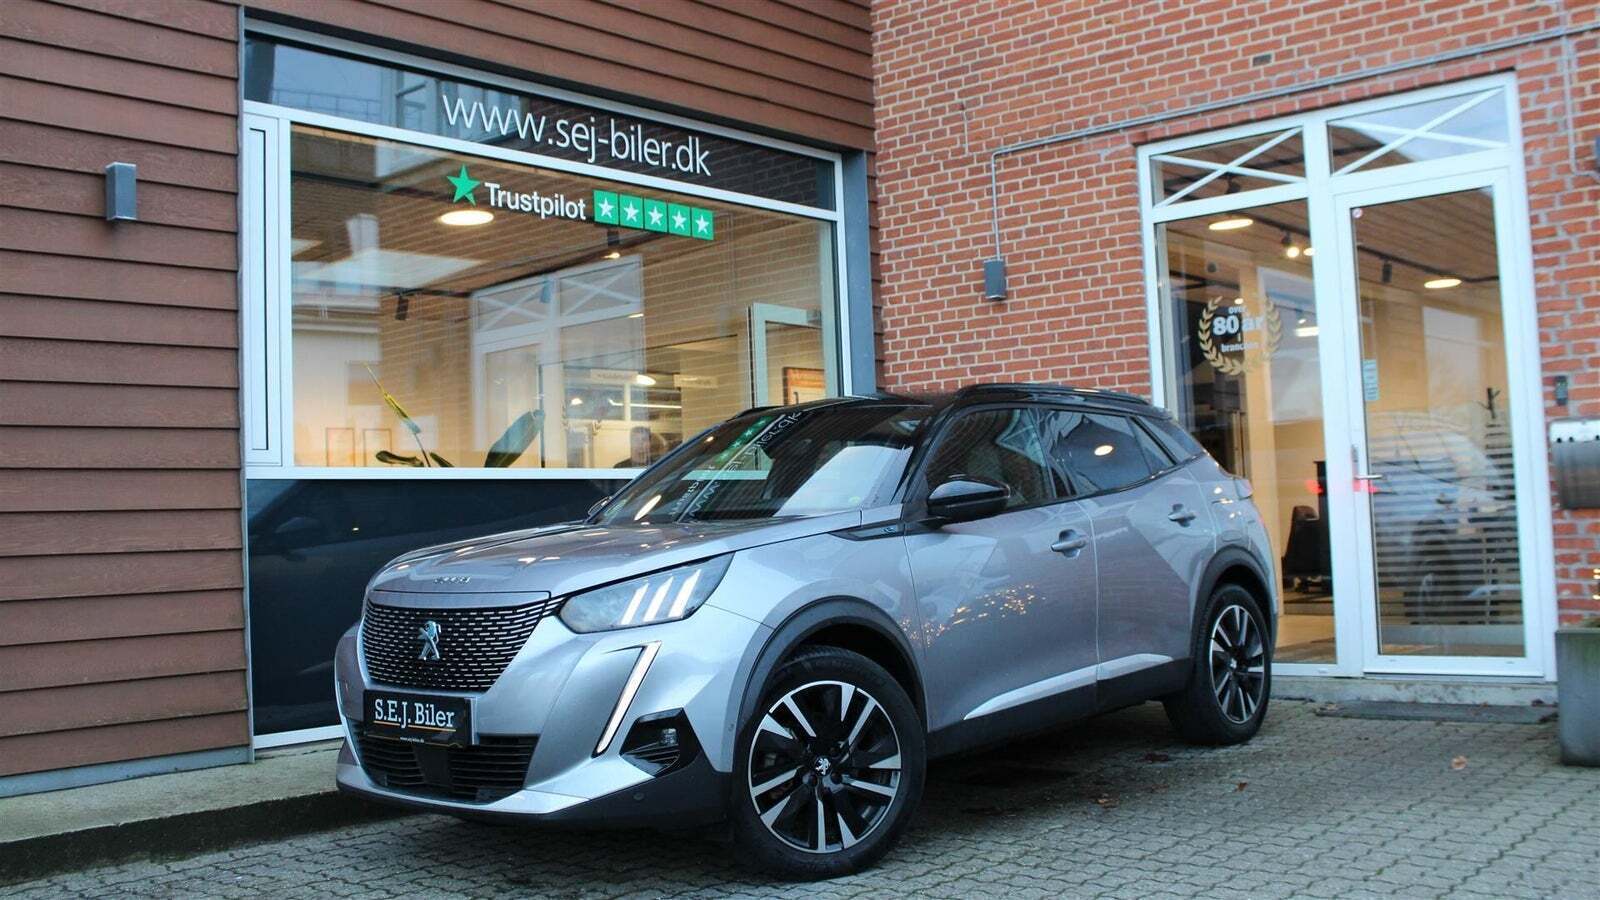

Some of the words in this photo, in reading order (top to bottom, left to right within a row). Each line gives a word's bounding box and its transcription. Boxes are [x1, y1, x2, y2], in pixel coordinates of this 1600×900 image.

[442, 94, 711, 177] www.sej-biler.dk
[484, 181, 586, 220] Trustpilot
[1212, 314, 1240, 336] 80
[374, 698, 411, 728] S.E.J.
[414, 702, 455, 728] Biler
